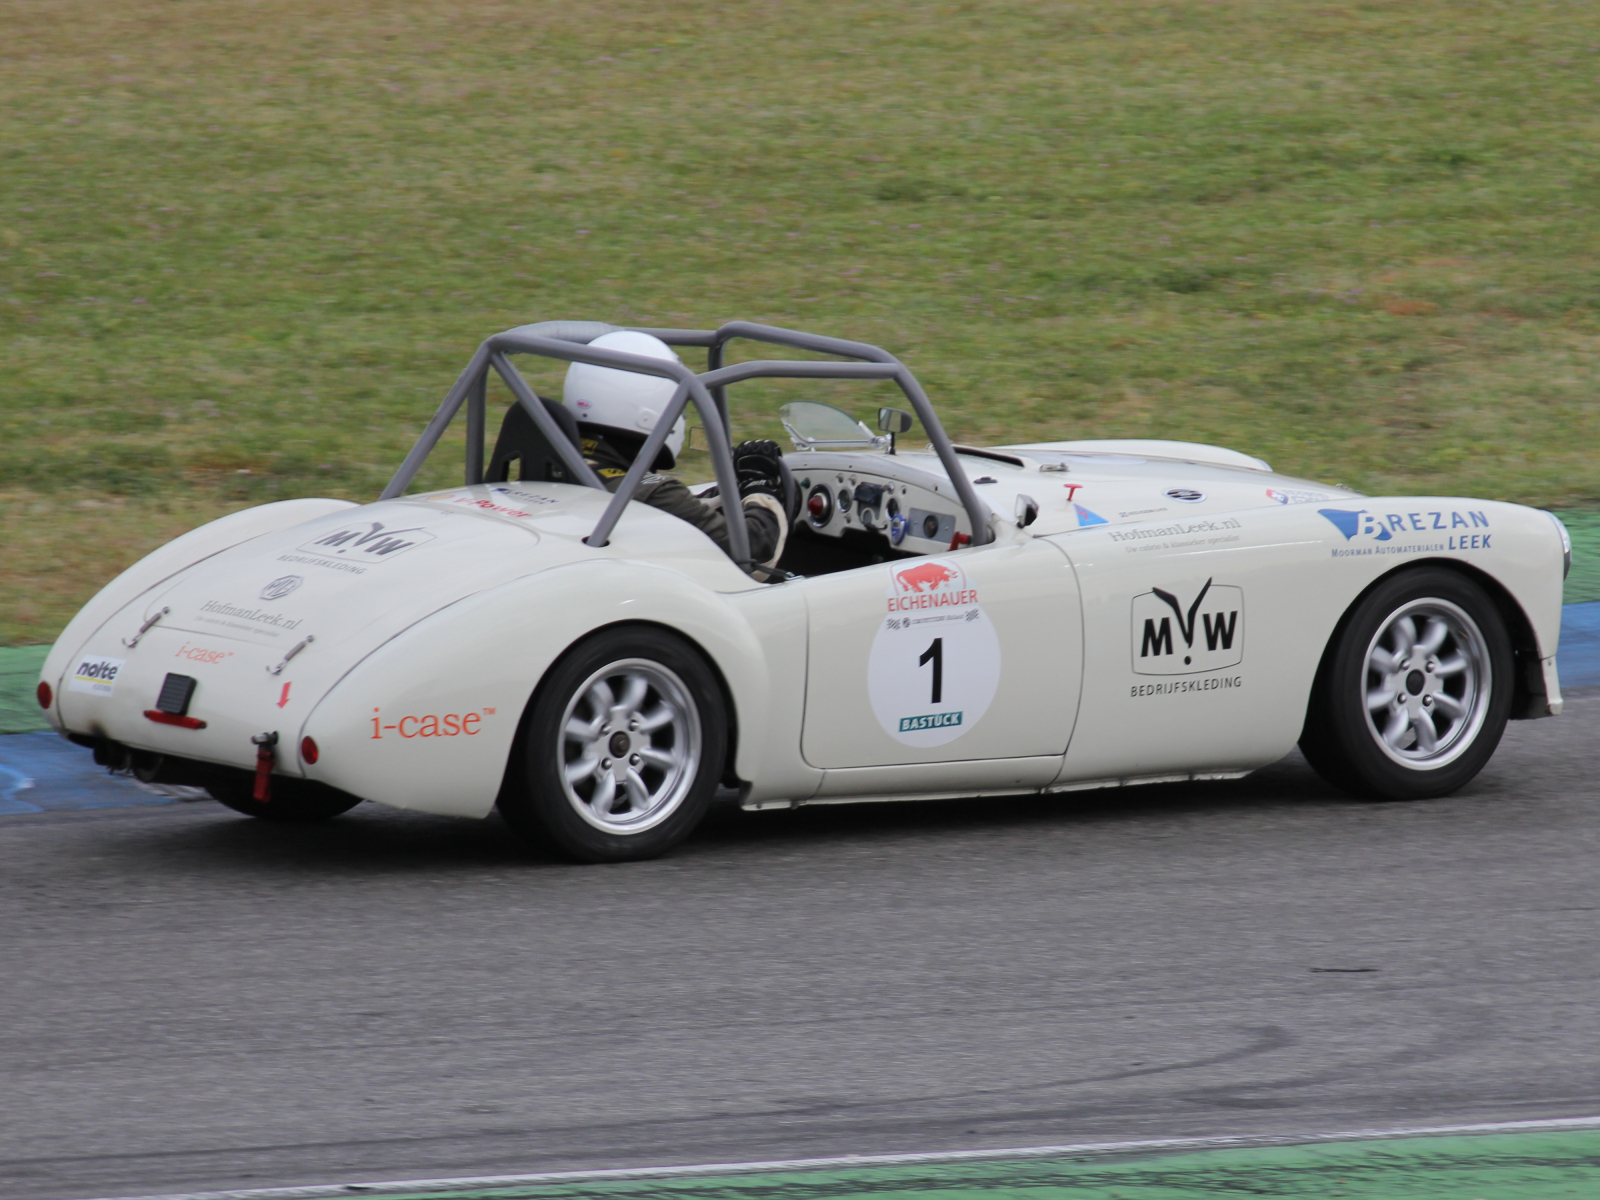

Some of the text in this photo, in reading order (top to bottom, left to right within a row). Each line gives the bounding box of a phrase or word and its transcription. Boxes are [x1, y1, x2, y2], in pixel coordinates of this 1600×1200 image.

[1108, 517, 1242, 542] HofmanLeek.nl
[1355, 509, 1490, 540] BREZAN
[1448, 533, 1492, 550] LEEK
[276, 554, 367, 575] BEDRIJFSKLEDING
[887, 589, 978, 612] EICHENAUER
[200, 600, 303, 630] HofmanLeek.nl
[76, 661, 118, 680] nolte
[918, 637, 943, 704] 1
[1130, 676, 1242, 697] BEDRIJFSKLEDING
